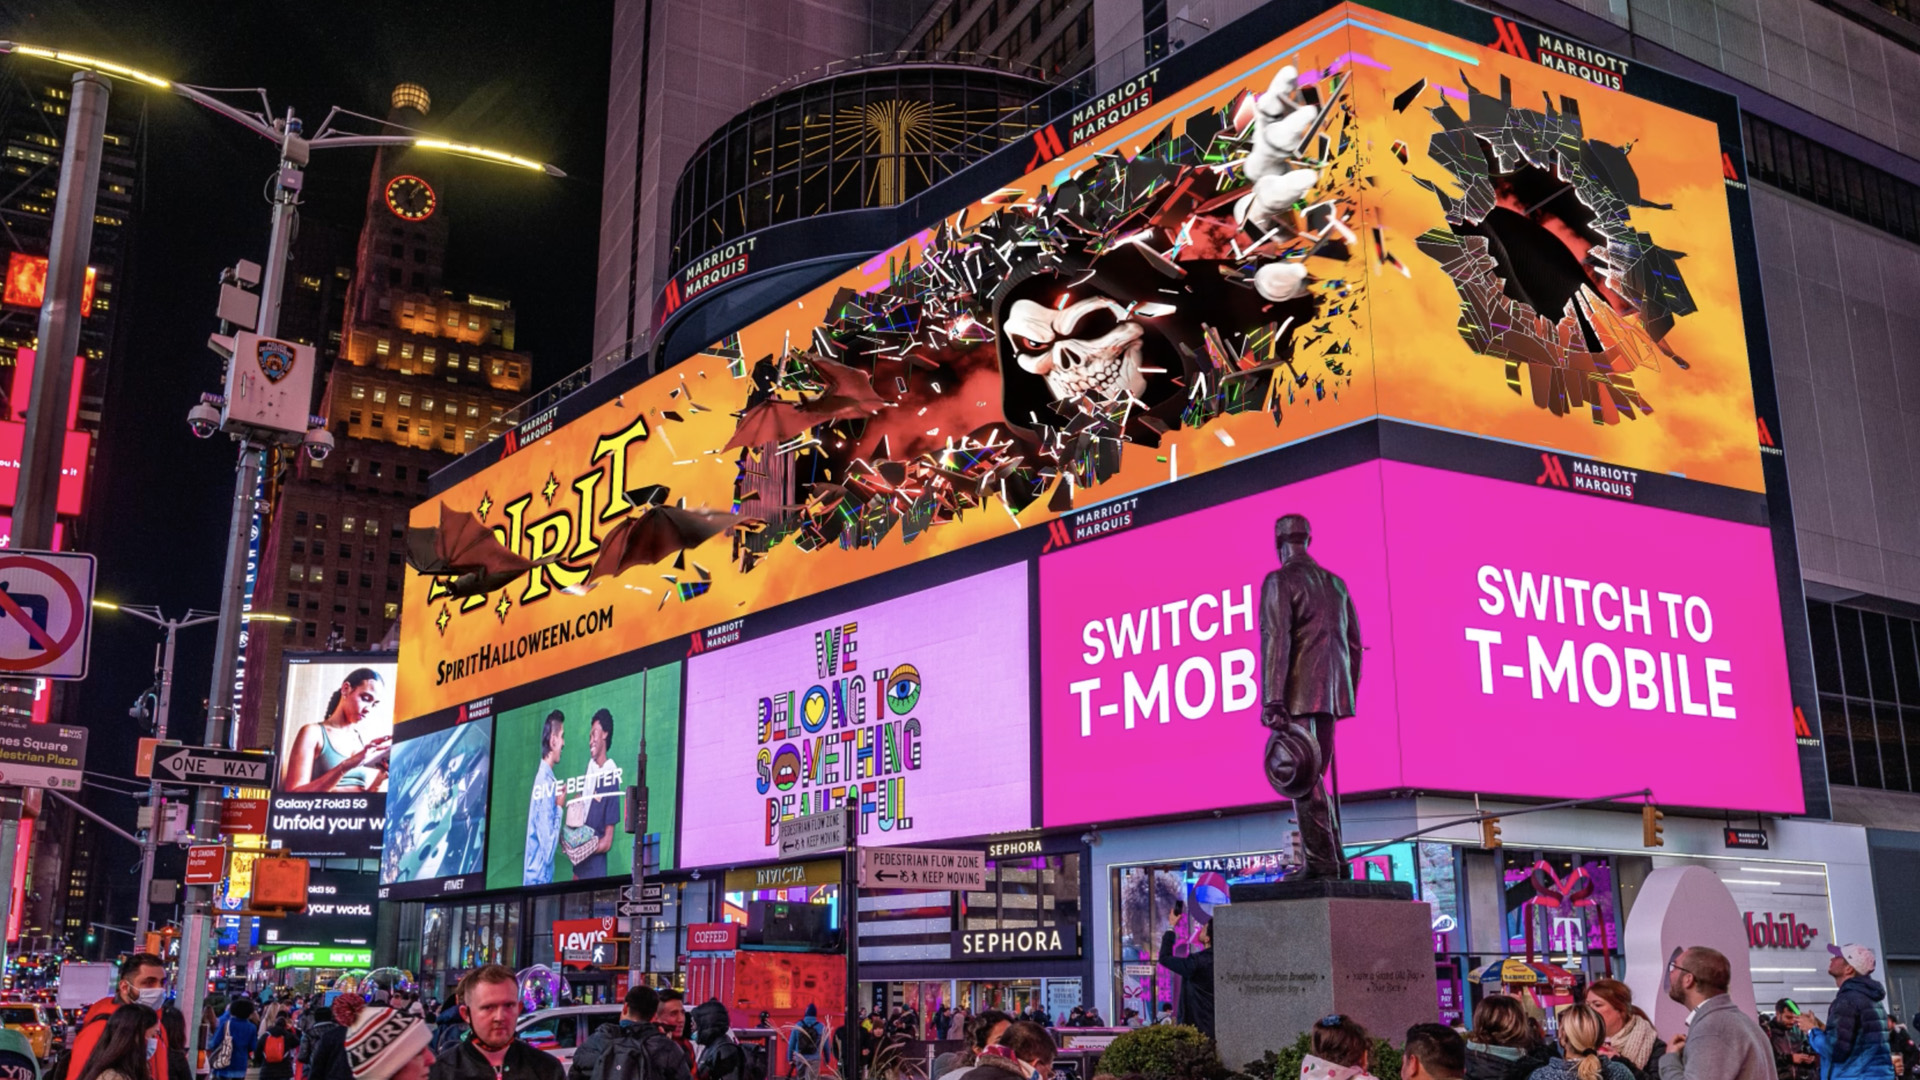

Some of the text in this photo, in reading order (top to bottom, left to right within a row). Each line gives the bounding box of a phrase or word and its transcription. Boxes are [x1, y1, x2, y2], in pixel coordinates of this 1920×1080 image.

[1539, 34, 1629, 75] MARRIOTT
[1541, 52, 1621, 91] MARQUIS
[1072, 69, 1160, 125] MARRIOTT
[1071, 92, 1150, 145] MARQUIS
[686, 237, 756, 279] MARRIOTT
[685, 257, 748, 298] MARQUIS
[521, 408, 558, 434] MARRIOTT
[520, 422, 553, 446] MARQUIS
[1573, 462, 1638, 483] MARRIOTT
[1575, 477, 1633, 497] MARQUIS
[428, 413, 650, 615] IRIT
[1076, 498, 1138, 525] MARRIOTT
[1076, 514, 1132, 539] MARQUIS
[1477, 565, 1713, 643] SWITCH TO
[707, 620, 744, 638] MARRIOTT
[1082, 584, 1254, 665] SWITCH
[707, 632, 740, 648] MARQUIS
[815, 622, 858, 679] WE
[1465, 627, 1737, 720] T-MOBILE
[1070, 648, 1258, 737] T-MOB
[468, 706, 491, 720] MARQUIS
[469, 698, 494, 712] MARRIOTT
[758, 663, 921, 745] BELONG TO
[23, 737, 69, 752] Square
[47, 753, 78, 766] Plaza
[756, 717, 922, 795] SOMETHING
[172, 757, 259, 777] ONE WAY
[532, 768, 623, 801] GIVE BETTER
[275, 799, 367, 811] Galaxy Z Fold3 5G
[273, 814, 325, 830] Unfold
[328, 818, 366, 835] your
[782, 813, 839, 837] PEDESTRIAN FLOW ZONE
[807, 829, 839, 847] KEEP MOVING
[989, 840, 1042, 857] SEPHORA
[198, 849, 216, 858] STANDING
[874, 853, 980, 868] PEDESTRIAN FLOW ZONE
[756, 865, 806, 885] INVICTA
[922, 871, 980, 885] KEEP MOVING
[308, 885, 336, 894] old3 5G
[644, 888, 658, 897] WAY
[308, 904, 371, 916] your world.
[623, 905, 637, 913] ONE
[694, 930, 729, 943] COFFEED
[962, 930, 1062, 954] SEPHORA
[329, 952, 355, 962] NEW
[351, 1013, 414, 1062] YORK
